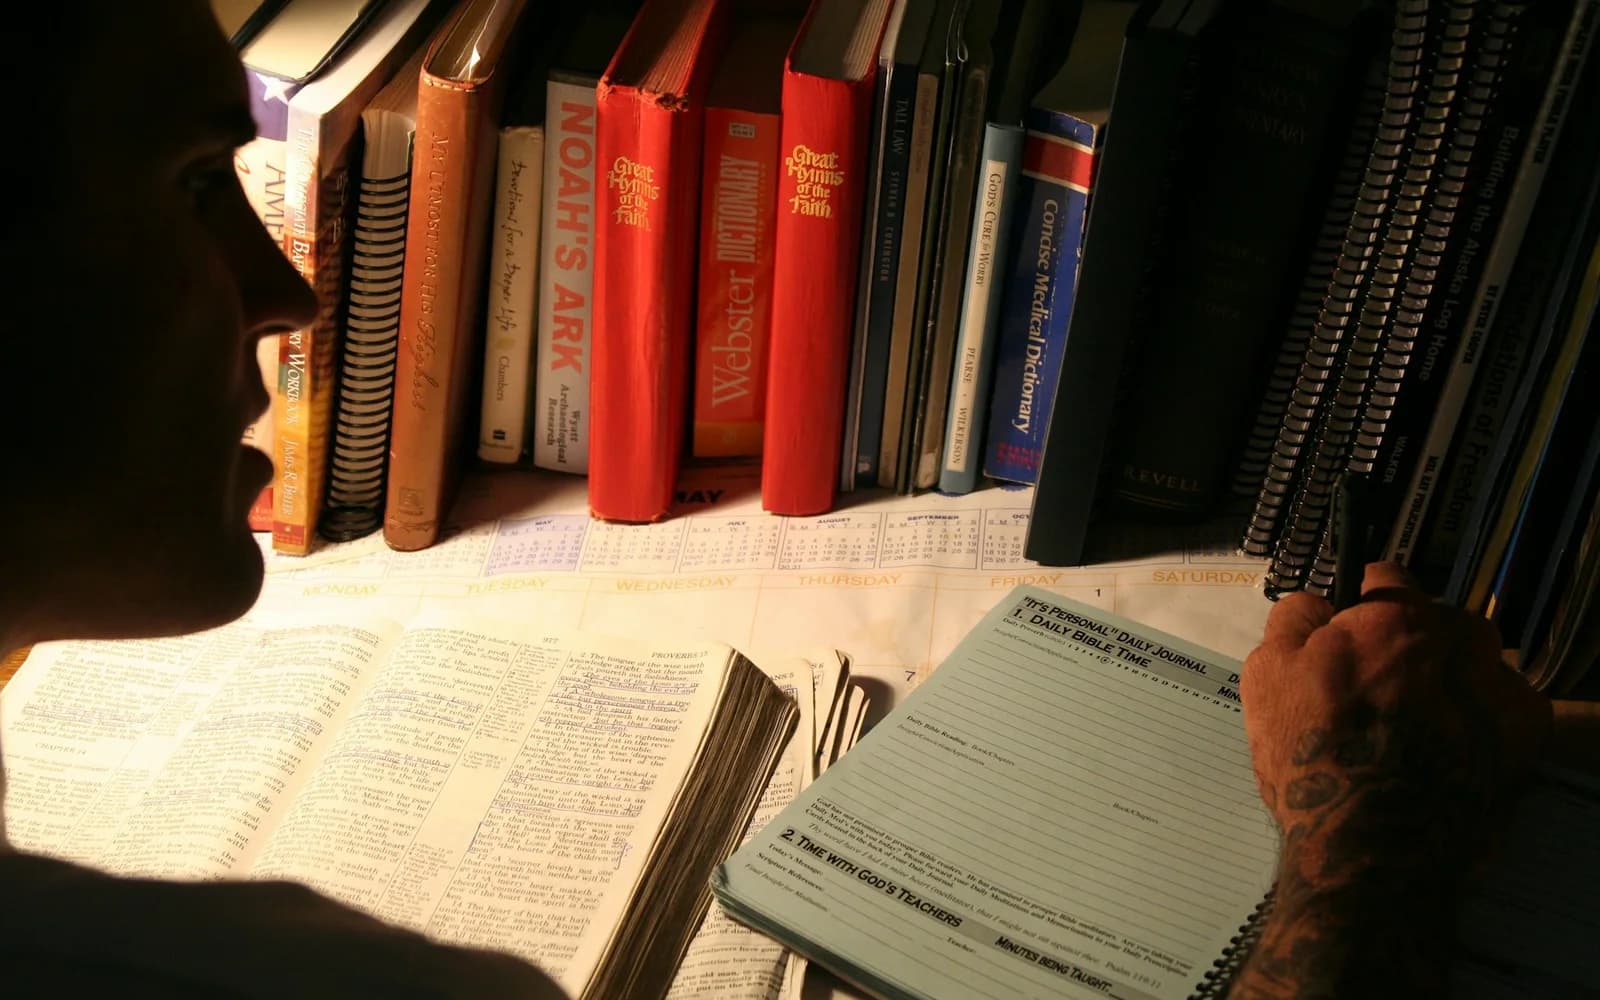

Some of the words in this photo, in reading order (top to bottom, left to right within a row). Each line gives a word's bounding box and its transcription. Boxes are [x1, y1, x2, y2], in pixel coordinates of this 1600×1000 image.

[793, 145, 838, 168] Great
[892, 130, 904, 153] LAW
[613, 157, 654, 182] Great
[785, 157, 844, 187] Hymns
[1480, 125, 1520, 200] Building
[555, 101, 597, 272] NOAH'S
[608, 170, 660, 200] Hymns
[620, 192, 633, 207] of
[797, 182, 811, 198] of
[812, 184, 830, 198] the
[986, 173, 1002, 210] GOD'S
[428, 170, 450, 241] UTMOST
[613, 207, 651, 231] Faith
[717, 154, 759, 263] DICTIONARY
[789, 196, 832, 219] Faith
[1470, 203, 1491, 233] the
[981, 211, 998, 241] CURE
[1036, 199, 1059, 271] Concise
[290, 238, 311, 276] BAPT
[424, 243, 441, 280] FOR
[975, 249, 991, 286] WORRY
[1451, 236, 1480, 295] Alaska
[497, 261, 520, 303] Deeper
[497, 305, 515, 332] Life
[1027, 274, 1050, 342] Medical
[1434, 296, 1460, 331] Log
[551, 283, 586, 375] ARK
[712, 269, 754, 407] Webster
[963, 347, 976, 384] PEARSE
[1419, 333, 1448, 381] Home
[283, 351, 305, 427] WORKBOOK
[496, 355, 508, 400] Chambers
[1011, 344, 1043, 434] Dictionary
[546, 397, 557, 446] Research
[557, 384, 570, 464] Archaeological
[570, 409, 582, 443] Wyatt
[952, 407, 968, 464] WILKERSON
[1475, 416, 1493, 435] of
[1383, 433, 1407, 484] WALKER
[1123, 464, 1200, 493] REVELL
[1444, 441, 1489, 530] Freedom
[303, 583, 381, 596] MONDAY
[465, 578, 550, 594] TUESDAY
[616, 575, 737, 592] WEDNESDAY
[799, 574, 904, 587] THURSDAY
[991, 572, 1065, 587] FRIDAY
[1095, 588, 1101, 598] 1
[1152, 571, 1260, 585] SATURDAY
[1012, 606, 1025, 619] 1.
[1028, 612, 1072, 637] DAILY
[1070, 629, 1115, 654] BIBLE
[1115, 646, 1152, 668] TIME
[1047, 605, 1118, 640] PERSONAL"
[1114, 630, 1154, 654] DAILY
[1151, 644, 1210, 675] JOURNAL
[651, 651, 698, 659] PROVERBS
[905, 670, 916, 681] 7
[636, 733, 675, 744] righteous
[905, 714, 923, 726] Daily
[922, 723, 940, 734] Bible
[611, 756, 632, 765] heart
[361, 814, 388, 826] driven
[393, 821, 418, 832] away
[574, 851, 609, 863] children
[768, 843, 794, 863] Today's
[810, 802, 829, 815] Daily
[849, 824, 864, 834] with
[864, 832, 877, 842] you
[903, 851, 926, 866] Please
[970, 883, 989, 896] Daily
[815, 797, 832, 809] God
[830, 805, 842, 815] has
[841, 812, 855, 821] not
[853, 818, 886, 838] promised
[891, 838, 918, 854] prosper
[918, 850, 937, 863] Bible
[977, 878, 990, 888] has
[825, 817, 848, 833] located
[893, 854, 908, 866] your
[909, 860, 925, 874] Daily
[530, 882, 553, 892] heart
[559, 886, 592, 897] maketh
[781, 829, 794, 842] 2.
[796, 835, 828, 859] TIME
[824, 851, 860, 876] WITH
[856, 867, 898, 895] GOD'S
[895, 886, 964, 928] TEACHERS
[487, 906, 510, 916] heart
[570, 915, 591, 925] hath
[994, 933, 1040, 962] MINUTES
[1037, 953, 1070, 976] BEING
